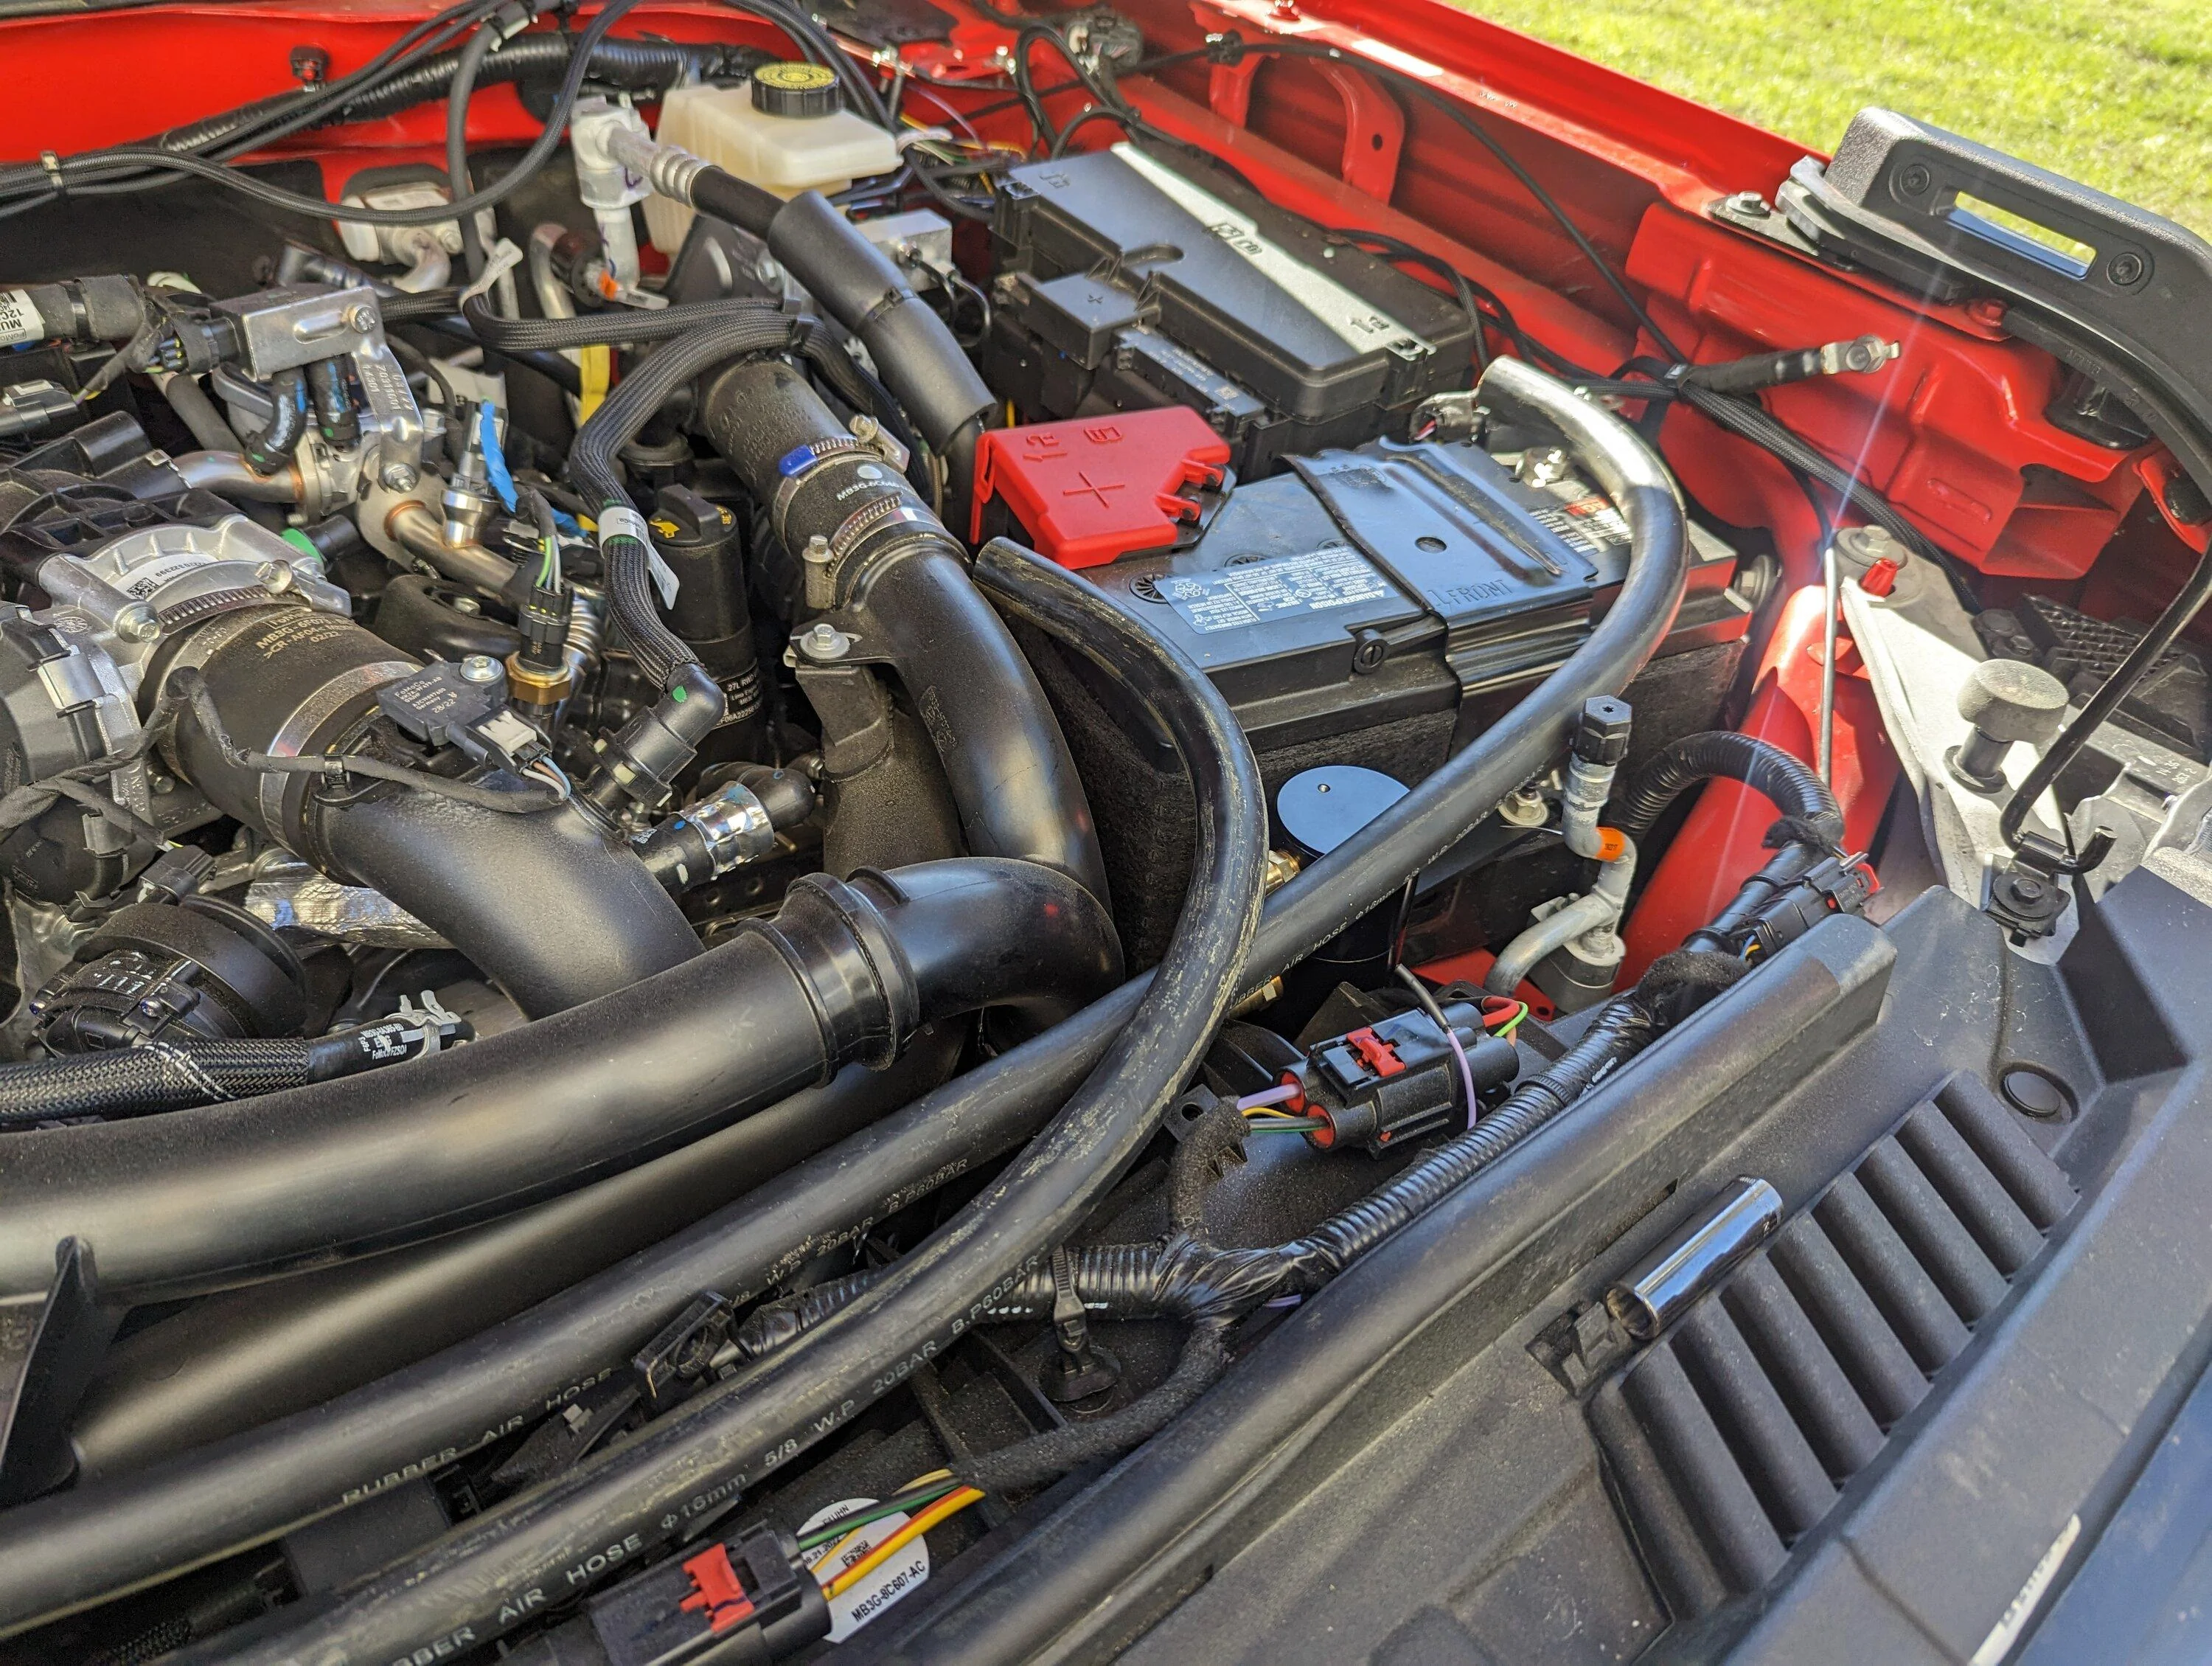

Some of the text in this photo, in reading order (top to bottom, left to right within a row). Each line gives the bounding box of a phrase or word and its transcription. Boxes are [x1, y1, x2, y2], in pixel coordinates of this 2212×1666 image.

[394, 680, 425, 698] FoMoCo
[1281, 953, 1304, 973] AIR
[1312, 922, 1348, 951] HOSE
[481, 1415, 524, 1444] AIR
[546, 1367, 613, 1410] HOSE
[498, 1587, 547, 1623] AIR
[565, 1533, 643, 1586] HOSE
[764, 1437, 799, 1468] 5/8
[813, 1399, 858, 1435] W.P
[871, 1339, 939, 1396] 20BAR
[851, 1560, 926, 1622] MB3G-8C607-AC
